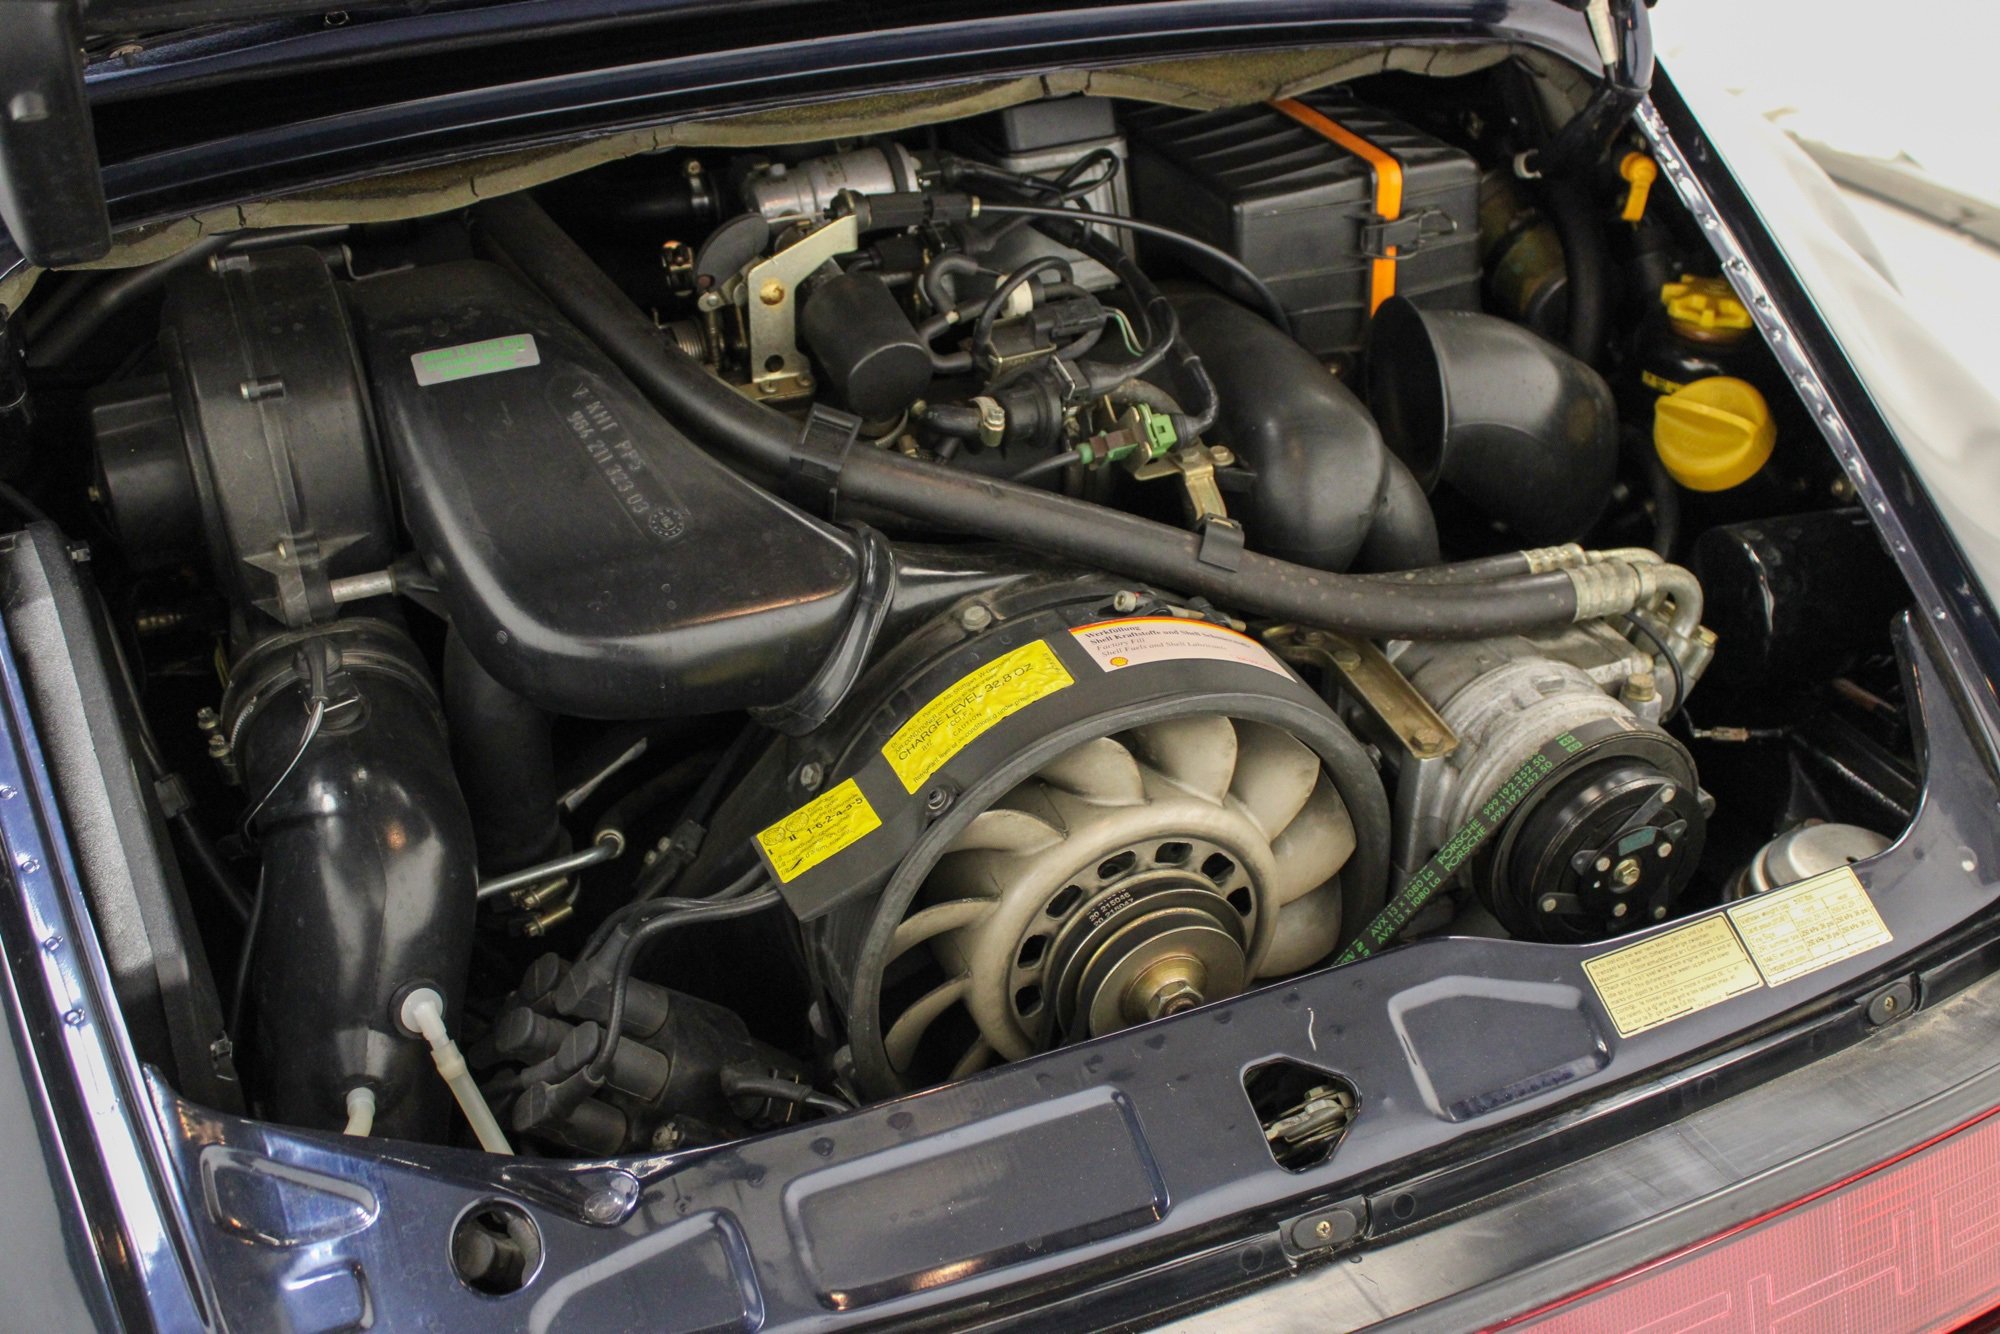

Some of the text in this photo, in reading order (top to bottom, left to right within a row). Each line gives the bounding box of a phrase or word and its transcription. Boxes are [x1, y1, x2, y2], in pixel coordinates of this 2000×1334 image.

[896, 718, 945, 760] CHARGE
[945, 688, 981, 721] LEVEL
[984, 672, 1012, 693] 32,8
[1013, 661, 1033, 677] OZ
[1089, 911, 1100, 922] 20
[1368, 916, 1388, 936] AVX
[1386, 905, 1399, 918] 13
[1404, 879, 1423, 899] 1080
[1422, 868, 1434, 880] La
[1437, 818, 1480, 863] PORSCHE
[1375, 924, 1394, 943] AVX
[1393, 912, 1405, 924] 13
[1411, 886, 1430, 906] 1080
[1429, 875, 1441, 887] La
[1445, 826, 1486, 871] PORSCHE
